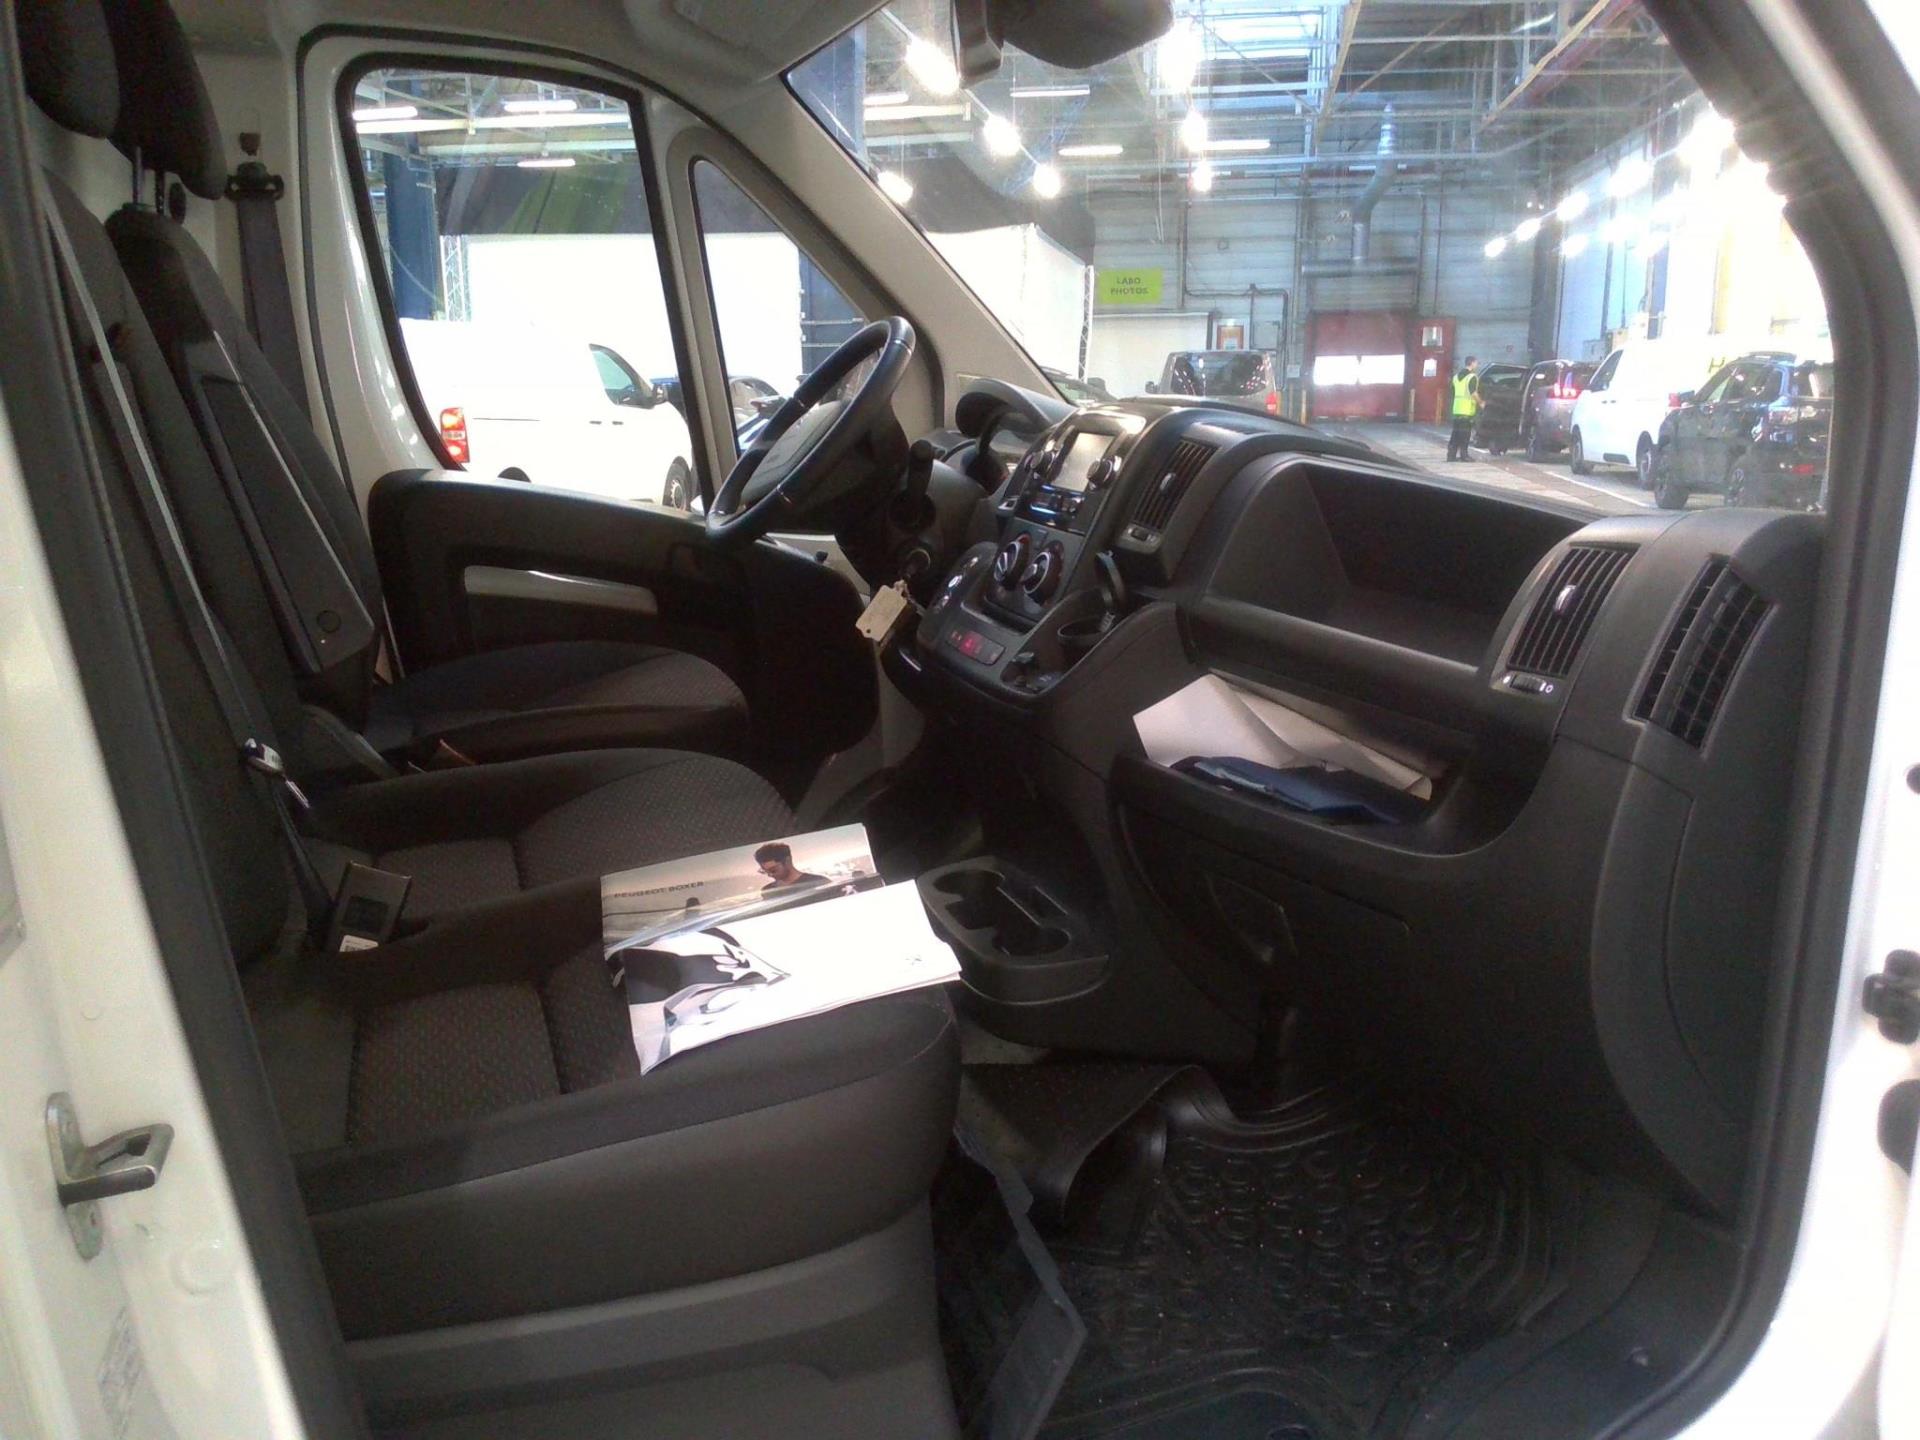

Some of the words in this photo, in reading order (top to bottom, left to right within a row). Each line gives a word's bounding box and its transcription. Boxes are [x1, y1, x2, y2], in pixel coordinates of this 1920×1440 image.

[1110, 287, 1149, 296] PHOTOS
[614, 886, 667, 898] PEUGEOT
[668, 881, 704, 892] BOXER
